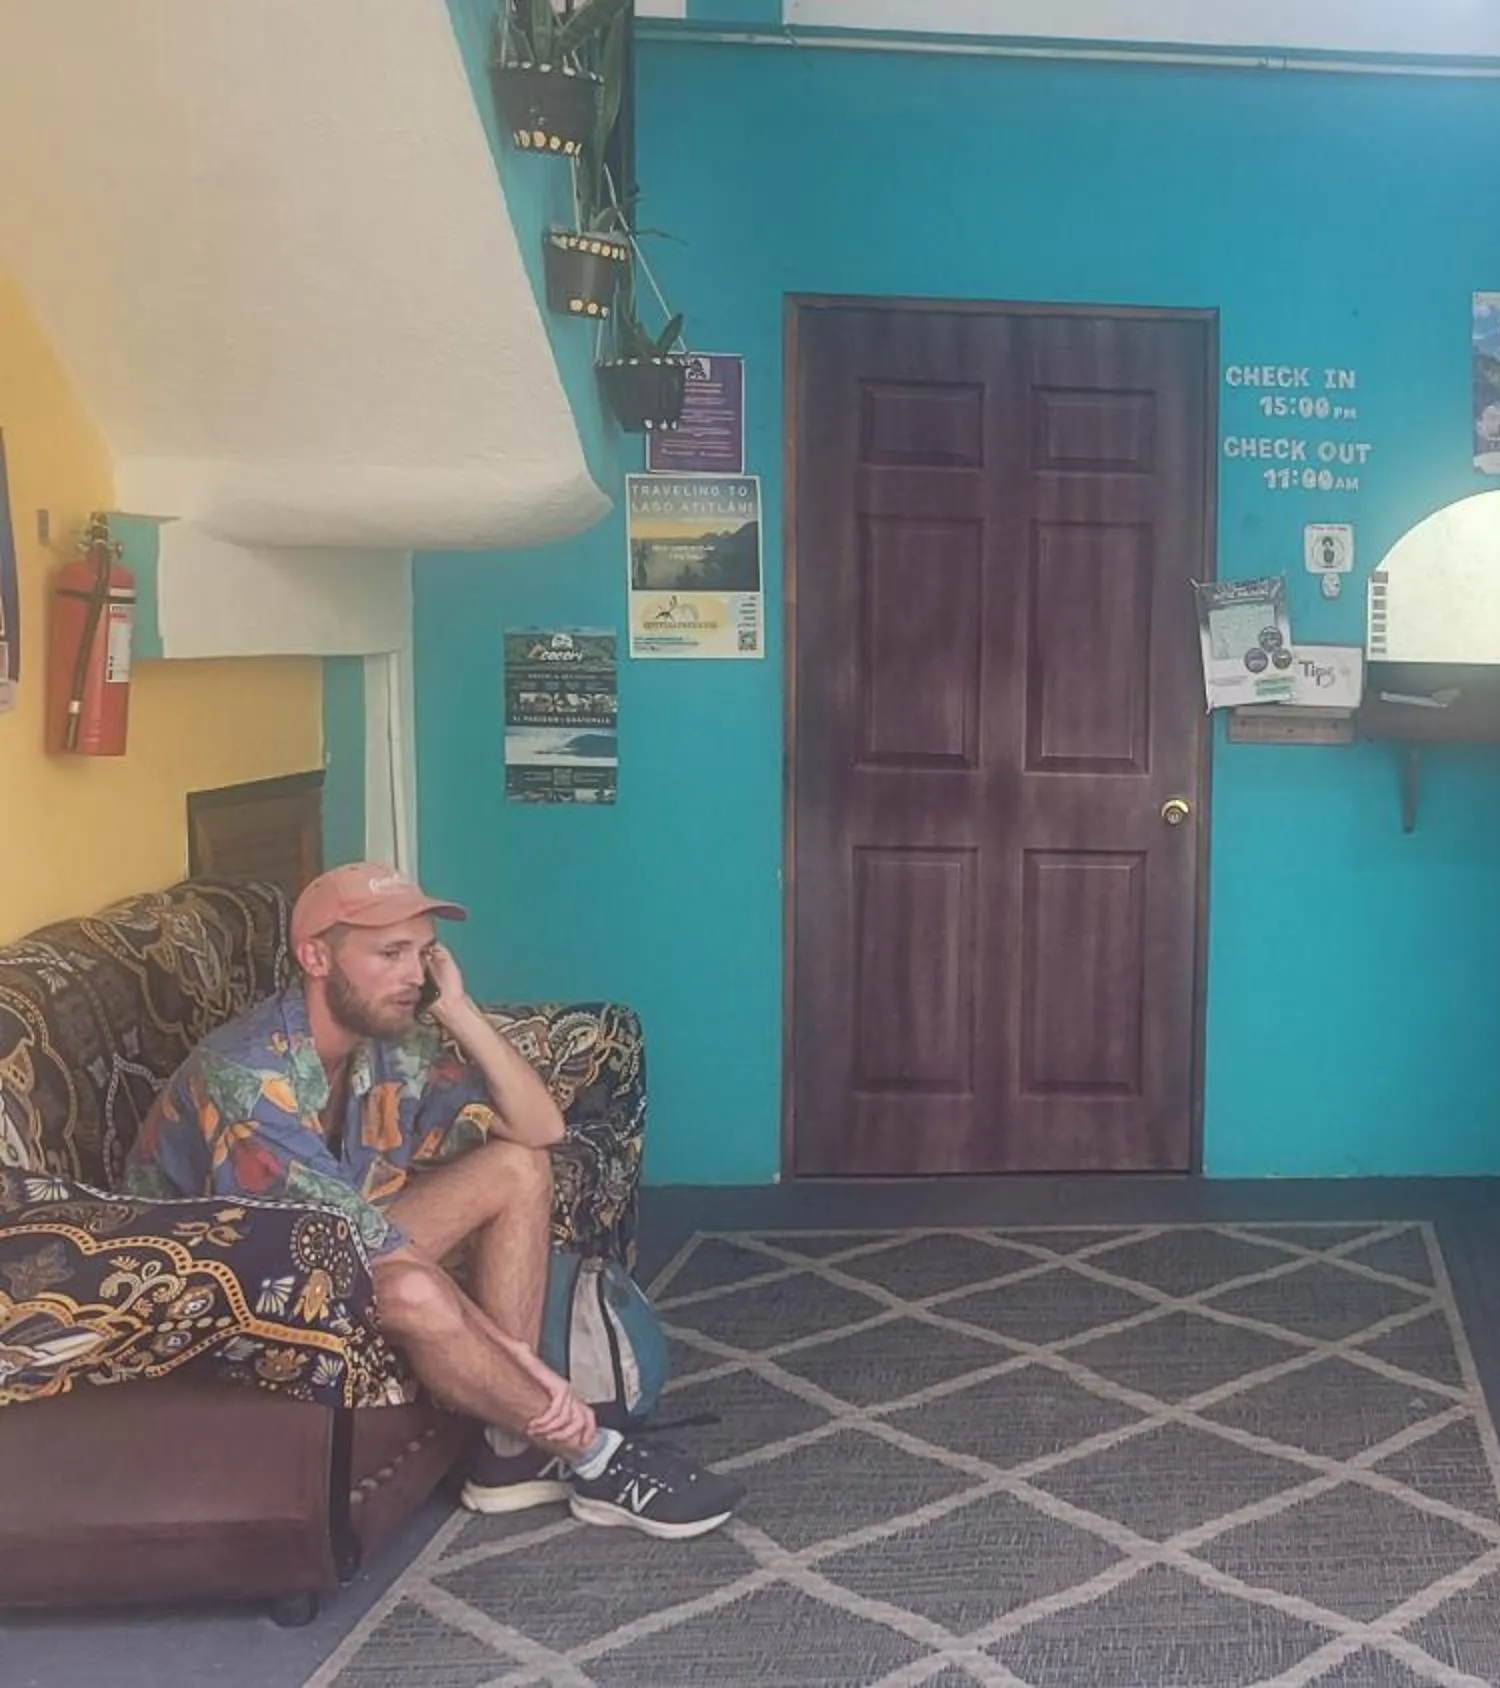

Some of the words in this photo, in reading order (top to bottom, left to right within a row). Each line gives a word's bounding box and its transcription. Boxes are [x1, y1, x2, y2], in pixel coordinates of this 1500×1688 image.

[1225, 365, 1309, 388] CHECK
[1325, 368, 1356, 389] IN
[1259, 396, 1329, 418] 15:00
[1333, 405, 1357, 419] PM
[1223, 436, 1307, 461] CHECK
[1317, 441, 1371, 464] OUT
[1264, 467, 1333, 490] 11:00
[632, 485, 720, 497] TRAVELING
[728, 485, 748, 497] TO
[631, 501, 673, 513] LAGO
